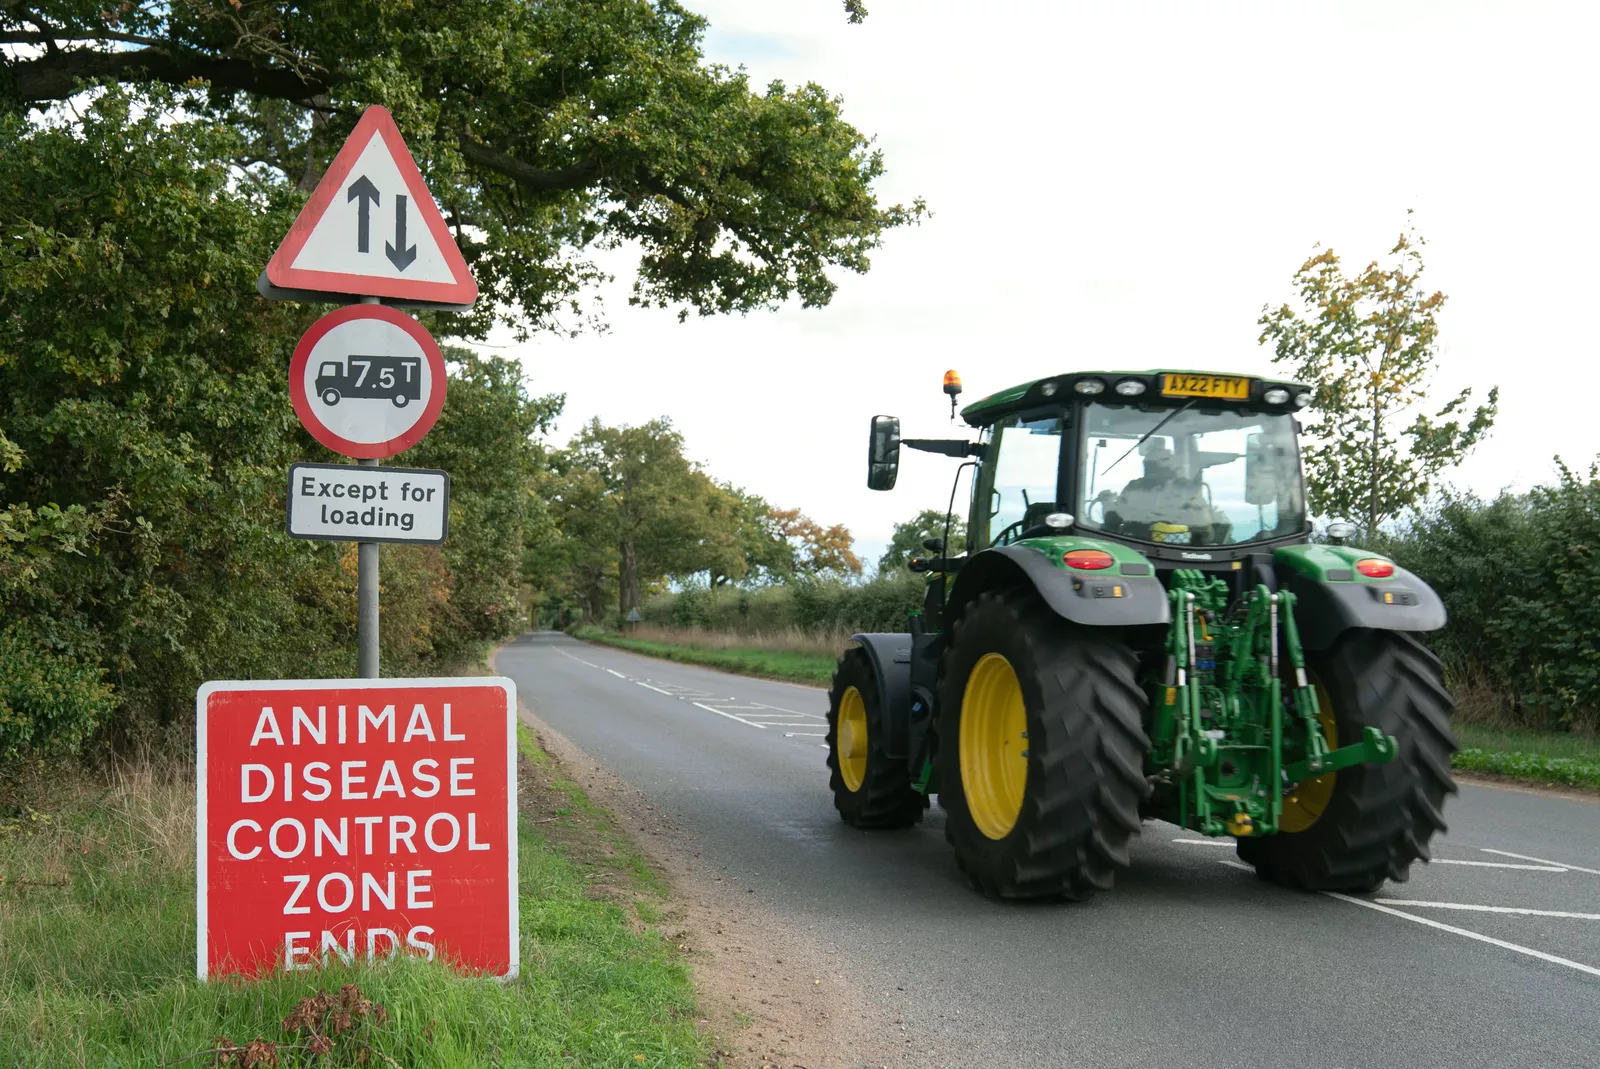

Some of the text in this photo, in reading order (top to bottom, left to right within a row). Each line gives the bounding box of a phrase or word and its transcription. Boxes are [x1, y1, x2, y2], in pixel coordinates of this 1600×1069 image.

[1169, 376, 1242, 394] AX22 FTY
[301, 476, 435, 503] Except for
[321, 504, 414, 531] loading
[250, 703, 466, 746] ANIMAL
[241, 757, 476, 803] DISEASE
[226, 812, 491, 861] CONTROL
[283, 869, 434, 915] ZONE
[284, 925, 436, 971] ENDS
